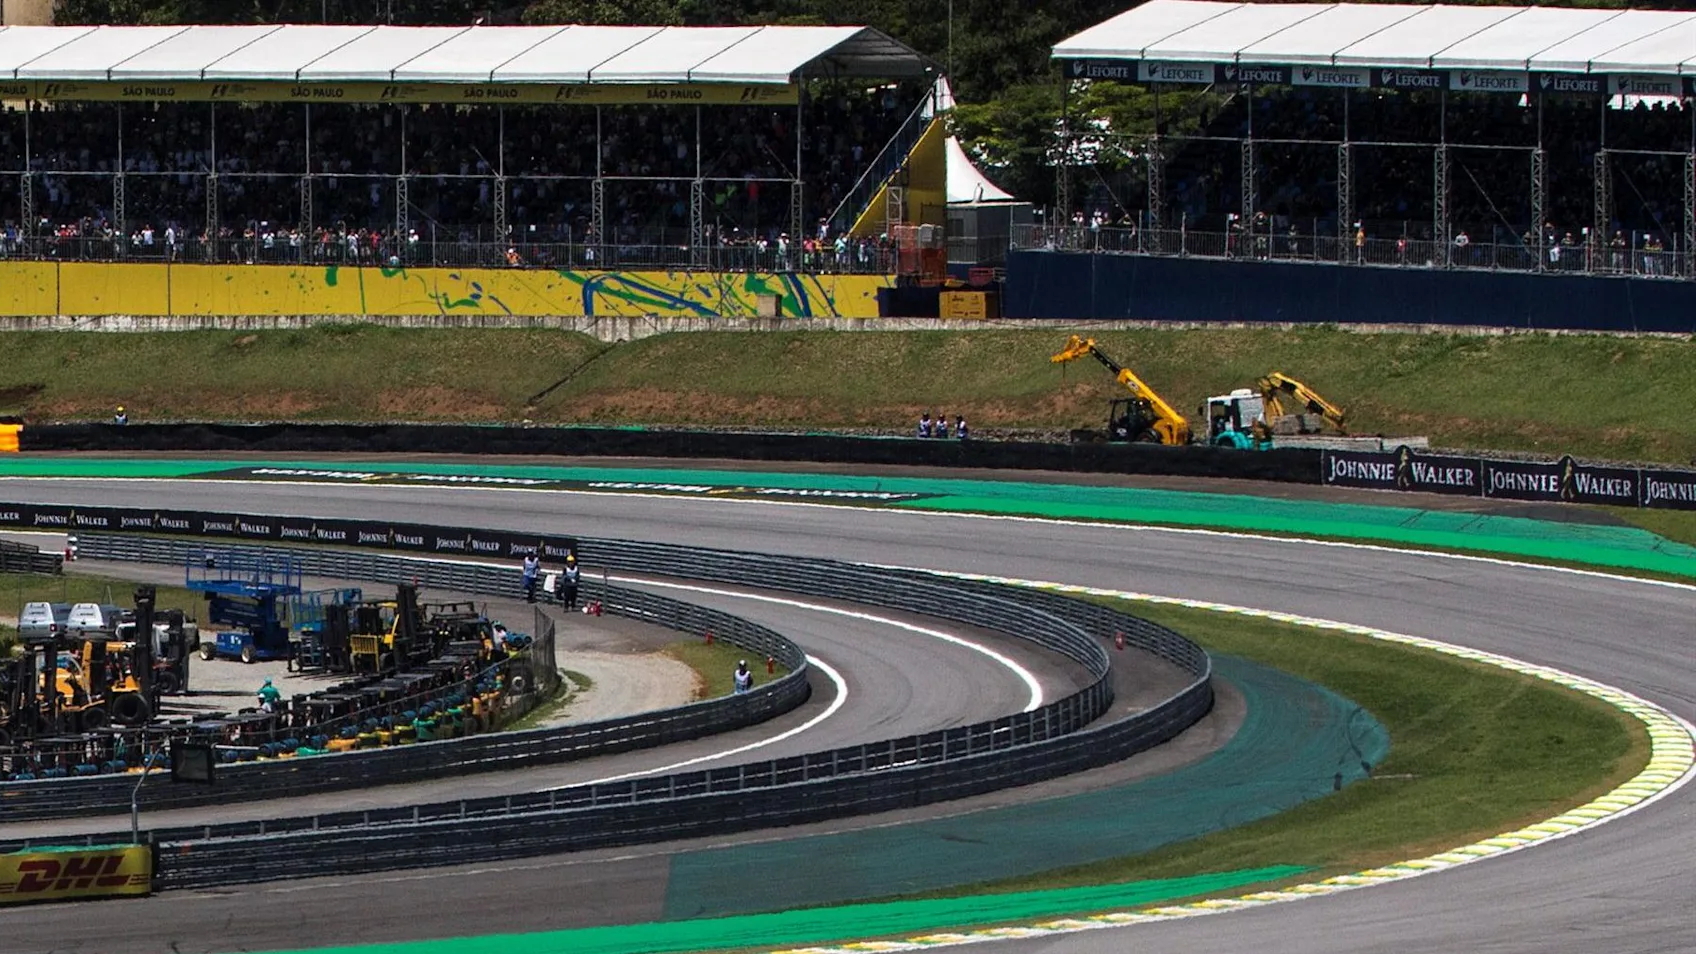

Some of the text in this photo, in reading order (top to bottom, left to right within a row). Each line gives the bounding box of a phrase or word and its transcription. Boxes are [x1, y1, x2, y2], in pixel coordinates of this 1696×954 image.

[1087, 65, 1128, 78] LEFORTE
[1161, 67, 1205, 80] LEFORTE
[1238, 69, 1282, 81] LEFORTE
[1316, 72, 1361, 85] LEFORTE
[1396, 74, 1440, 86] LEFORTE
[1473, 75, 1518, 88] LEFORTE
[1554, 78, 1598, 91] LEFORTE
[144, 87, 175, 96] PAULO
[313, 88, 343, 97] PAULO
[487, 88, 518, 98] PAULO
[1630, 80, 1673, 93] LEFORTE
[671, 90, 702, 99] PAULO
[1328, 456, 1474, 486] JOHNNIE WALKER
[1489, 468, 1632, 497] JOHNNIE WALKER
[34, 513, 108, 526] JOHNNIE WALKER
[120, 517, 189, 528] JOHNNIE WALKER
[203, 520, 270, 534] JOHNNIE WALKER
[280, 526, 346, 540] JOHNNIE WALKER
[358, 531, 424, 545] JOHNNIE WALKER
[436, 537, 500, 551] JOHNNIE WALKER
[17, 856, 130, 892] DHL
